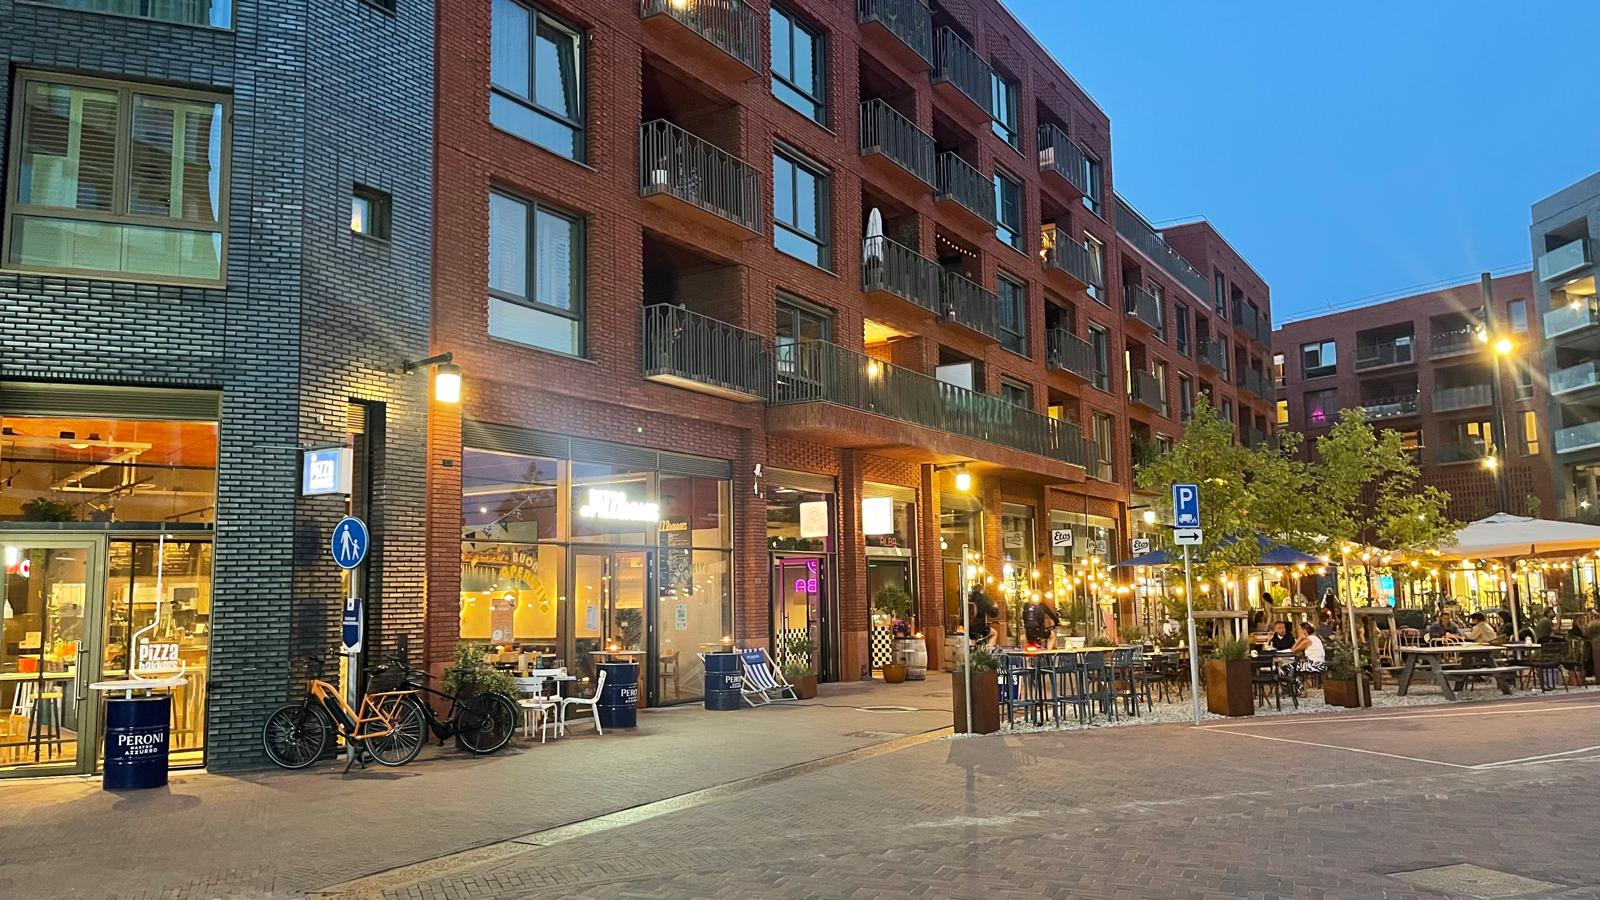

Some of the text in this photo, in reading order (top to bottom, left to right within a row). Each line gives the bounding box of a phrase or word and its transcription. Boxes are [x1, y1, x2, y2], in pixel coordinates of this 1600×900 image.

[1180, 488, 1193, 510] P
[1054, 531, 1071, 541] Etos
[1134, 540, 1148, 549] Etos
[118, 733, 164, 746] PERONI
